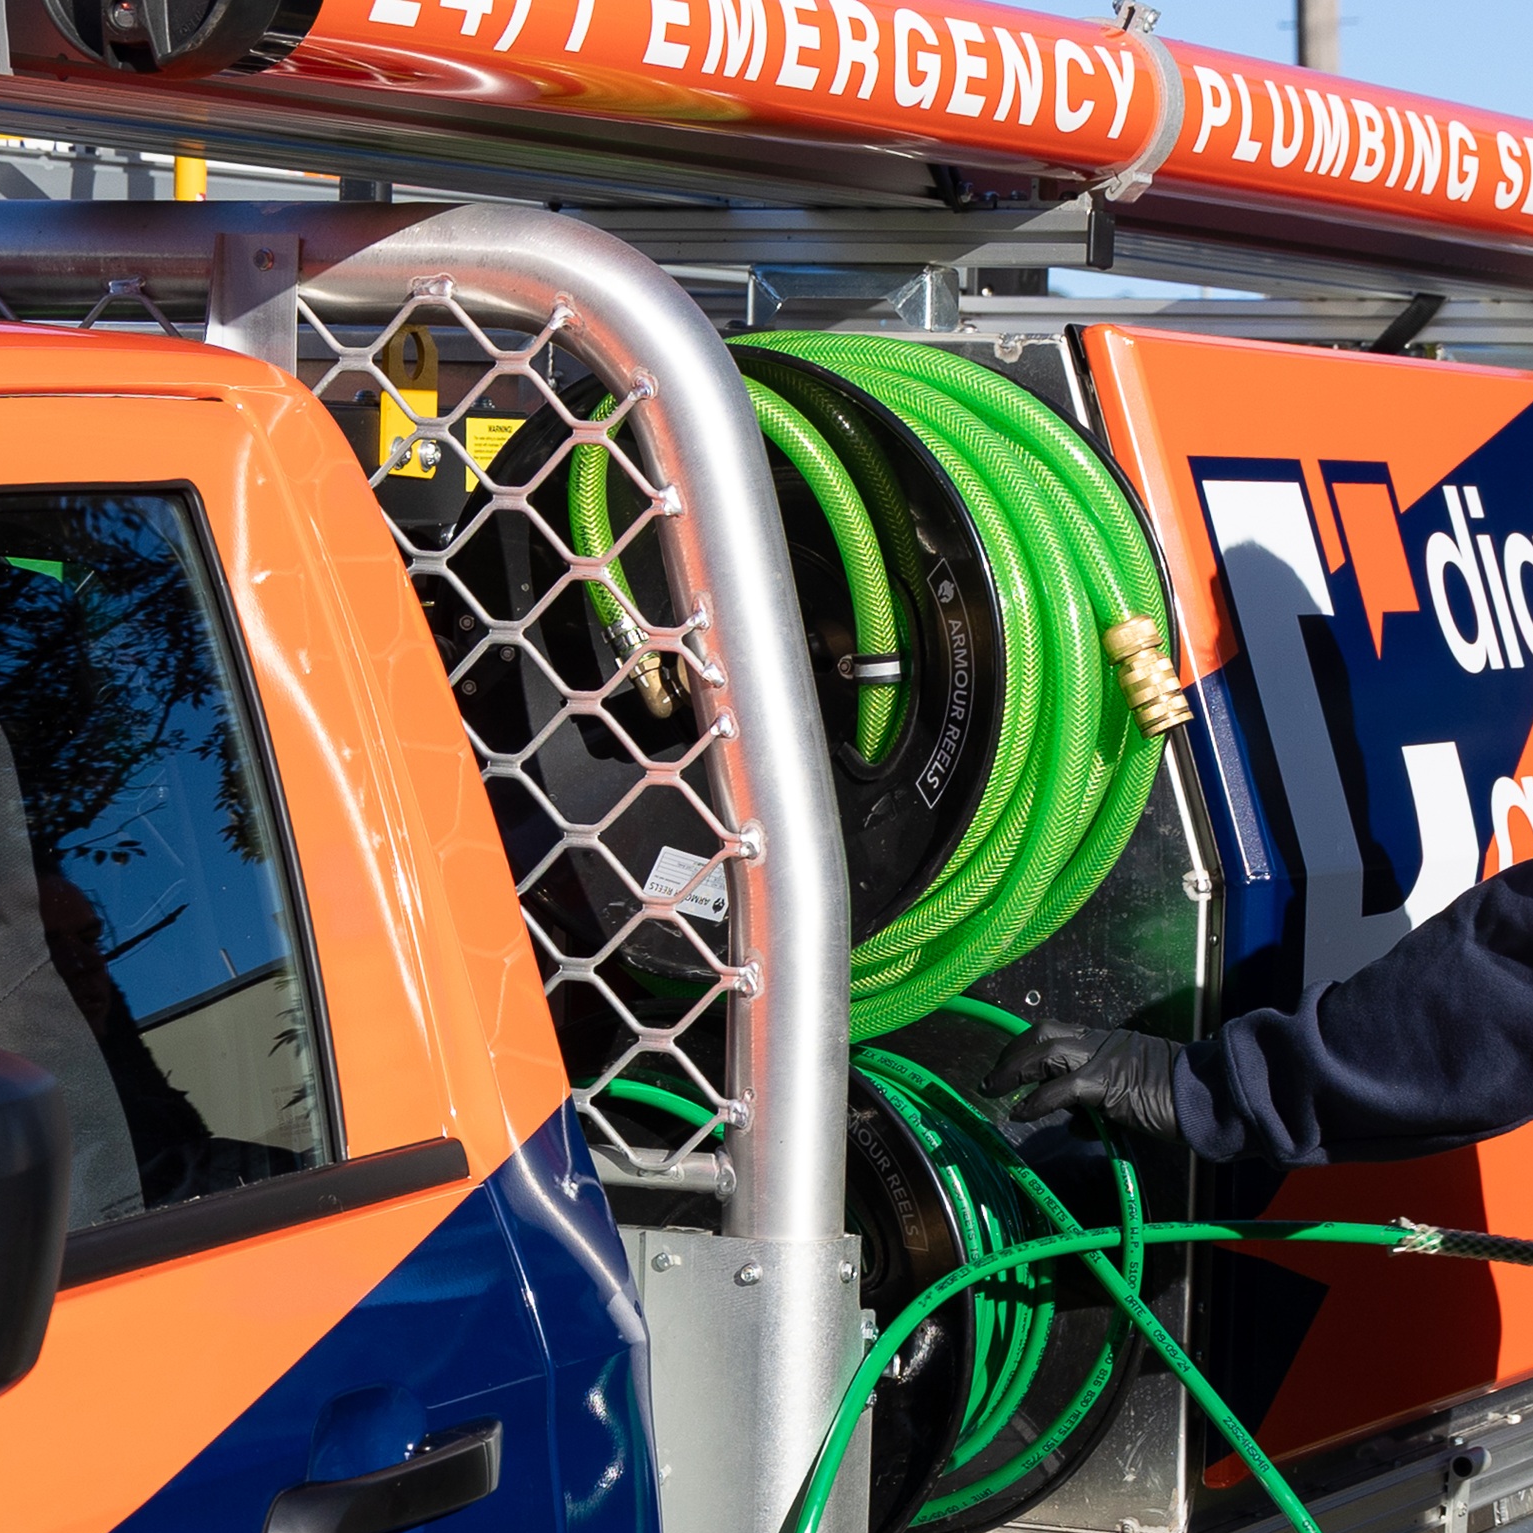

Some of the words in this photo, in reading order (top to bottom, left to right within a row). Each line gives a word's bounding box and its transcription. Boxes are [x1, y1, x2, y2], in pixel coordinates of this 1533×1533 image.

[642, 0, 1136, 140] EMERGENCY
[1195, 65, 1480, 203] PLUMBING
[948, 618, 968, 721] ARMOUR
[927, 726, 961, 790] REELS
[887, 1173, 919, 1236] REELS
[1044, 1196, 1069, 1223] MEETS
[1125, 1295, 1146, 1318] DATE
